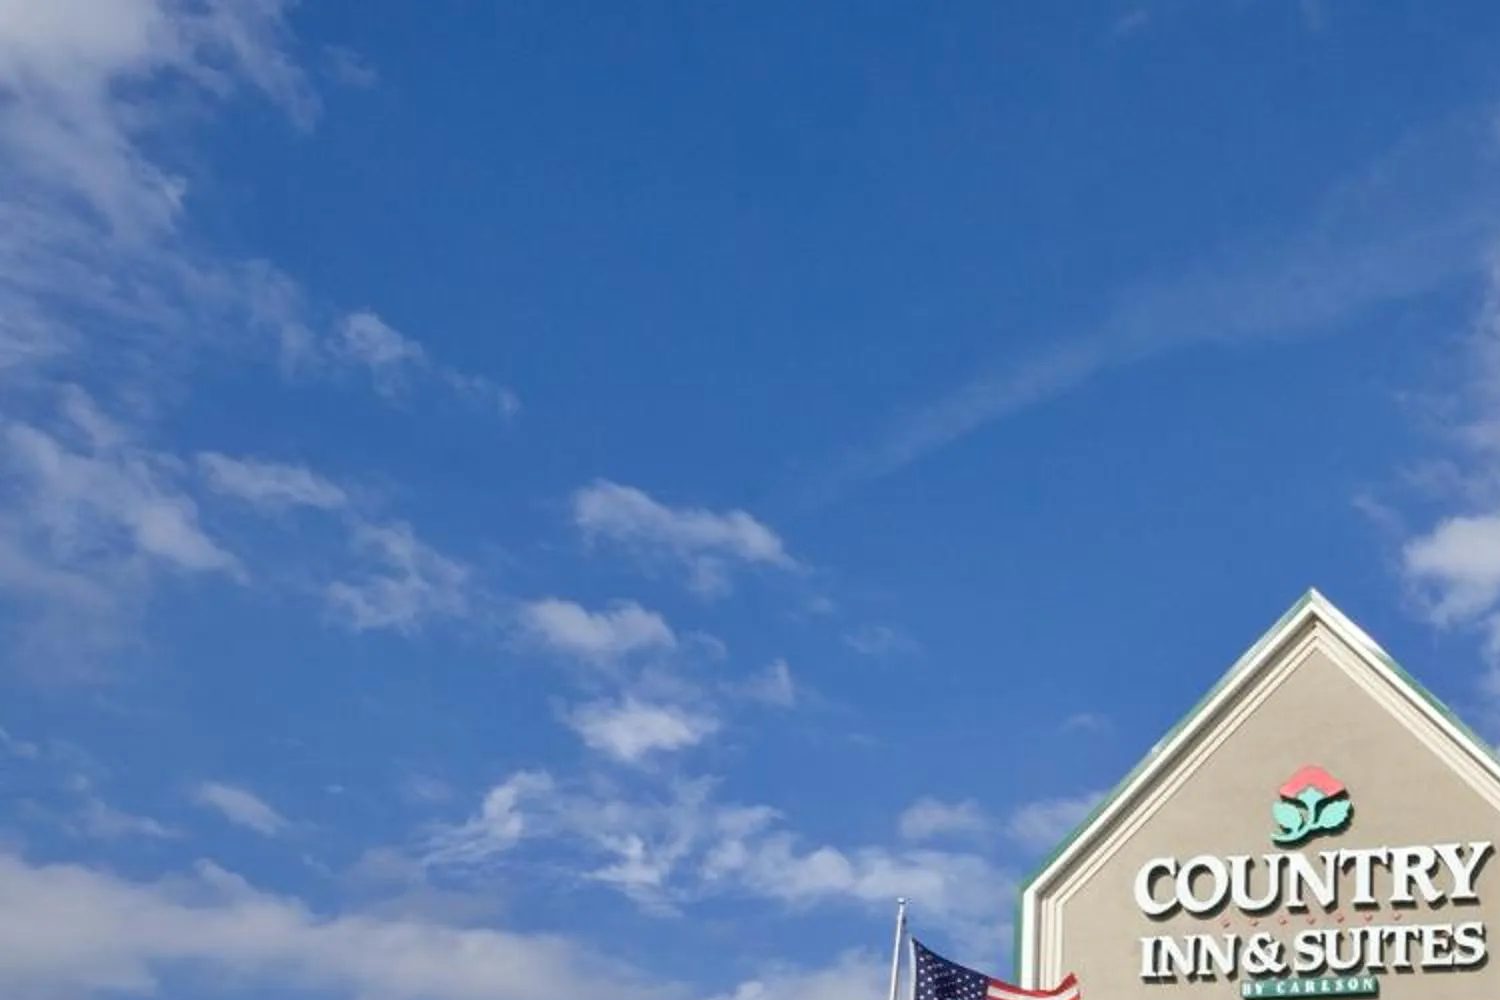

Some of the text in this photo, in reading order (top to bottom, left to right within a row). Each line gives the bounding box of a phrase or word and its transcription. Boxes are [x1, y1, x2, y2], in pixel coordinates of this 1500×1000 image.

[1134, 841, 1491, 915] COUNTRY
[1139, 921, 1486, 977] INN & SUITES
[1242, 978, 1374, 995] BY CARLSON
